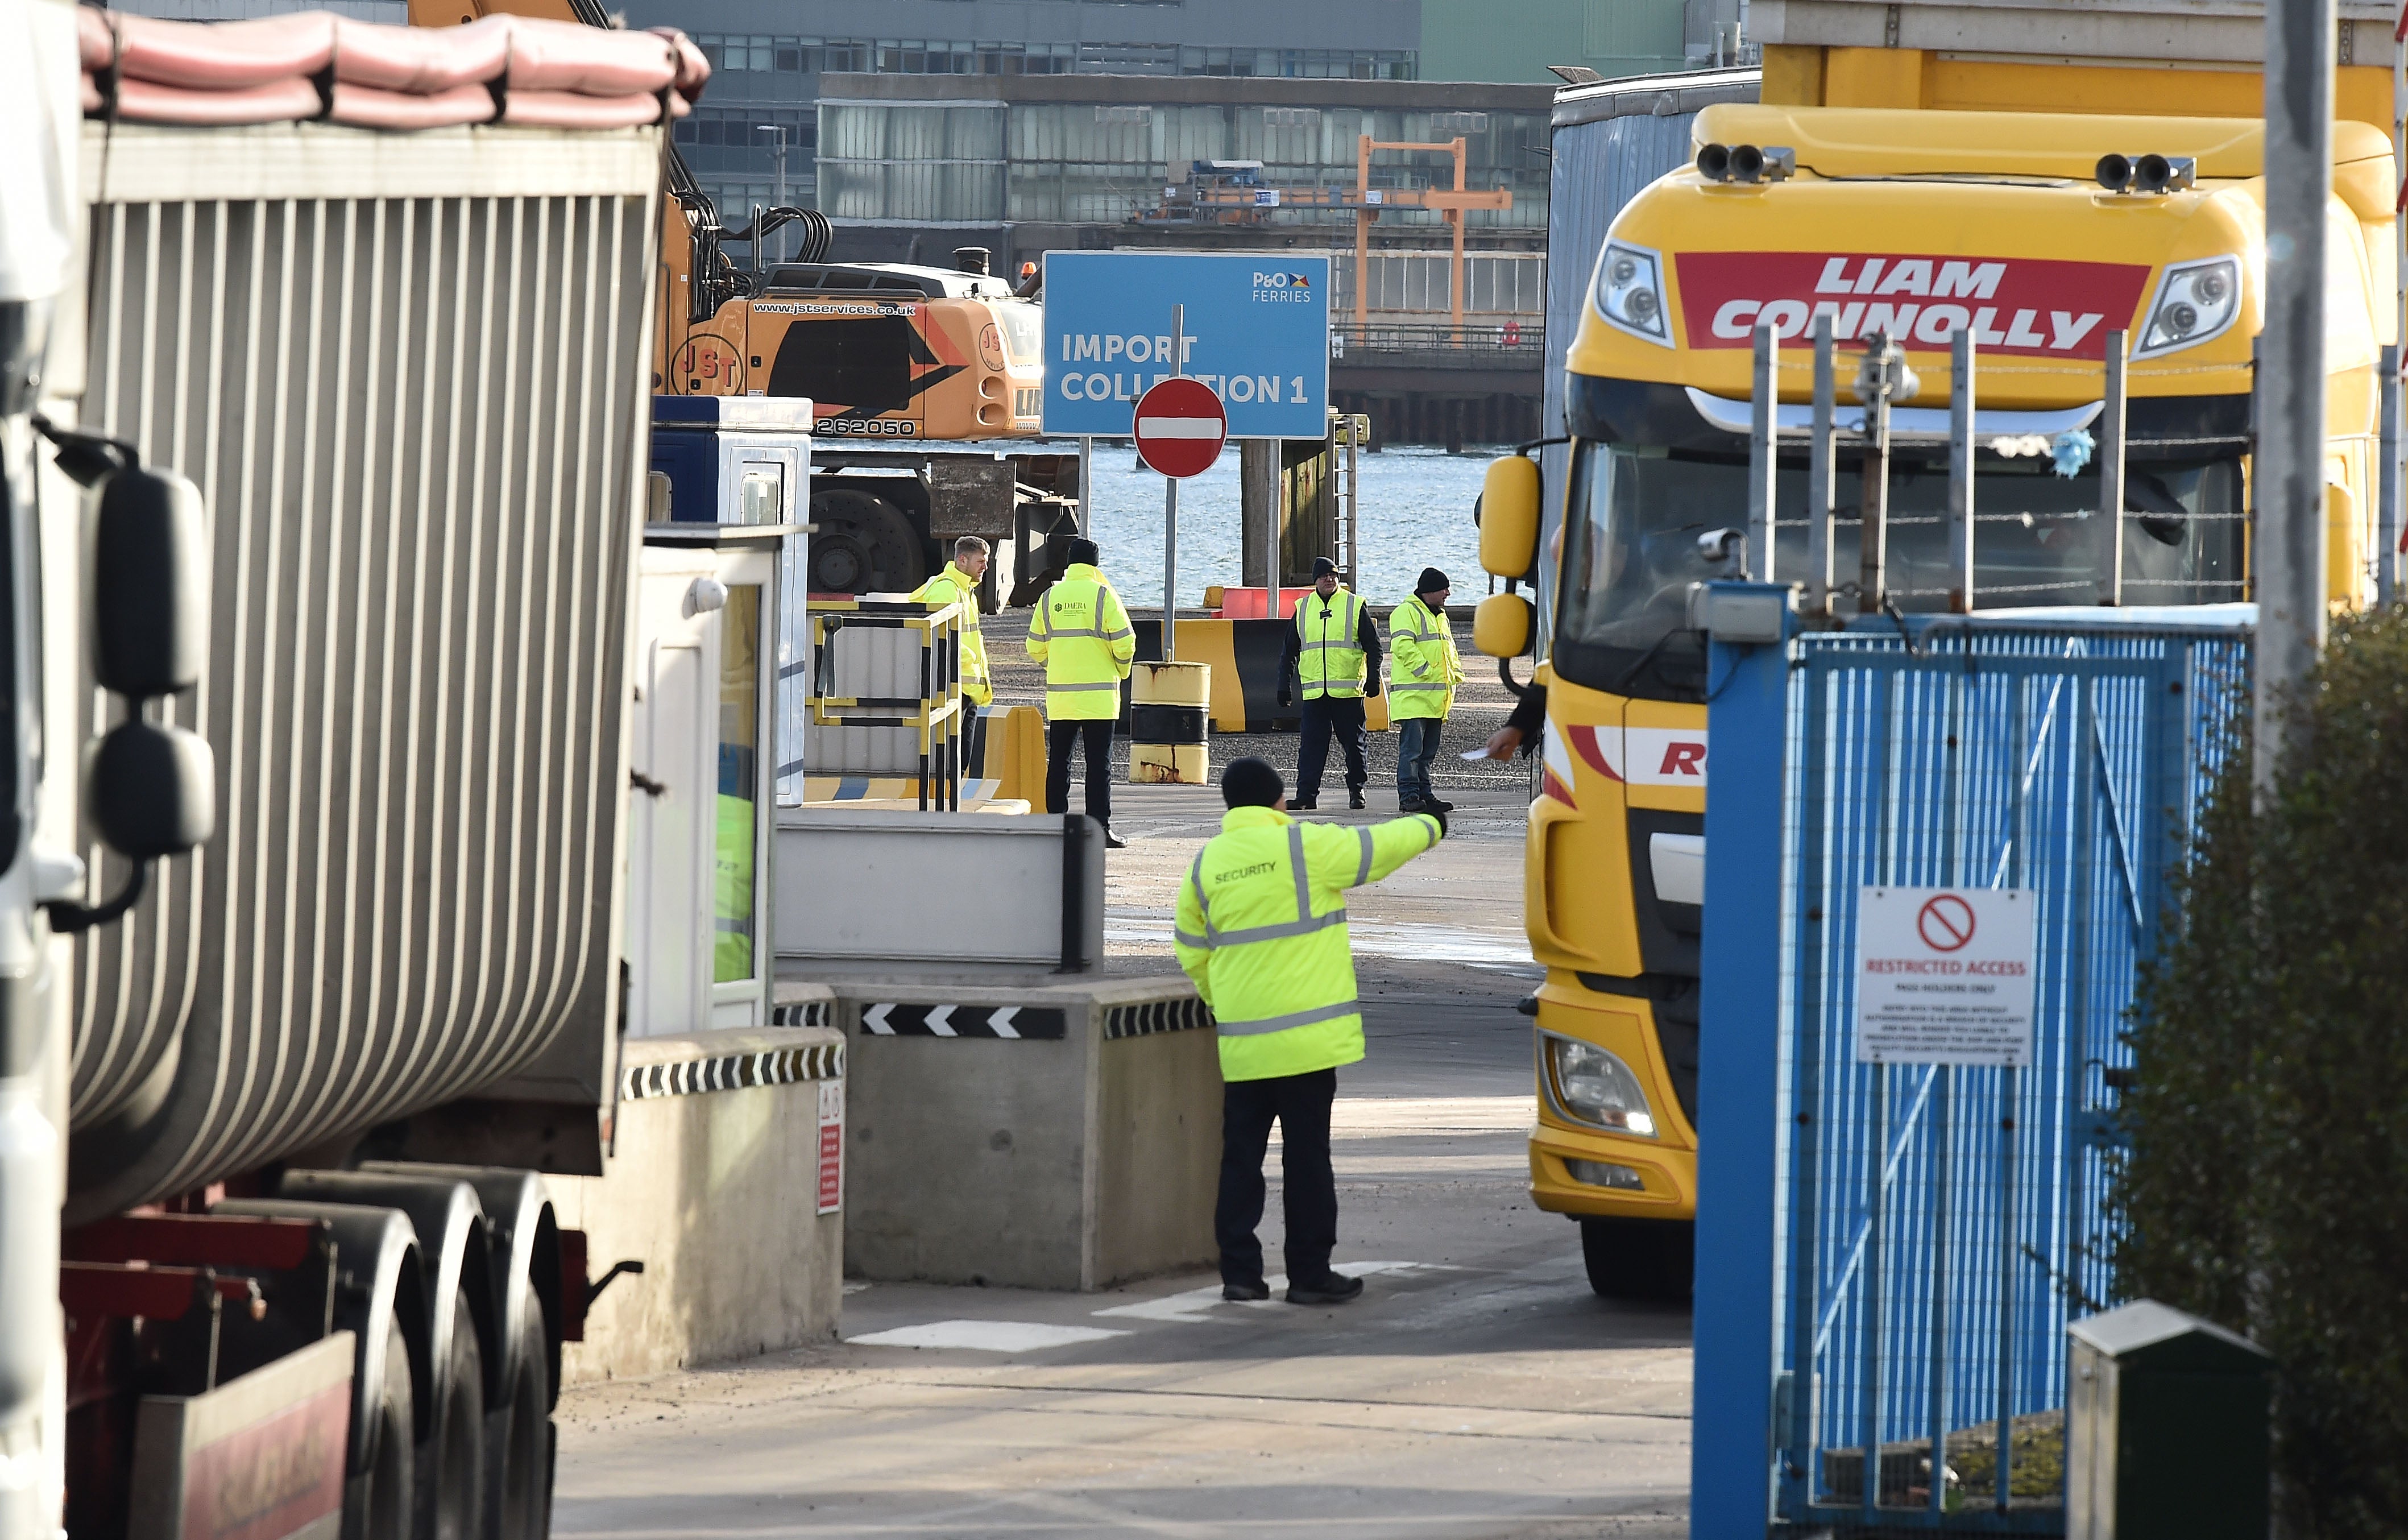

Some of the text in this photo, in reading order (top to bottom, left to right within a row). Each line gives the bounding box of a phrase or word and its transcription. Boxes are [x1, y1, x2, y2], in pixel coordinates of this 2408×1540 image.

[1253, 272, 1287, 288] P&O
[1814, 258, 2007, 299] LIAM
[1253, 290, 1311, 303] FERRIES
[753, 302, 915, 317] www.jstservices.co.uk
[1711, 299, 2104, 350] CONNOLLY
[983, 330, 1000, 351] JS
[1062, 334, 1197, 363] IMPORT
[680, 343, 736, 387] JST
[1061, 372, 1308, 403] COLLTION 1
[817, 419, 915, 436] 262050
[1215, 862, 1276, 884] SECURITY
[1866, 959, 2026, 977] RESTRICTED ACCESS
